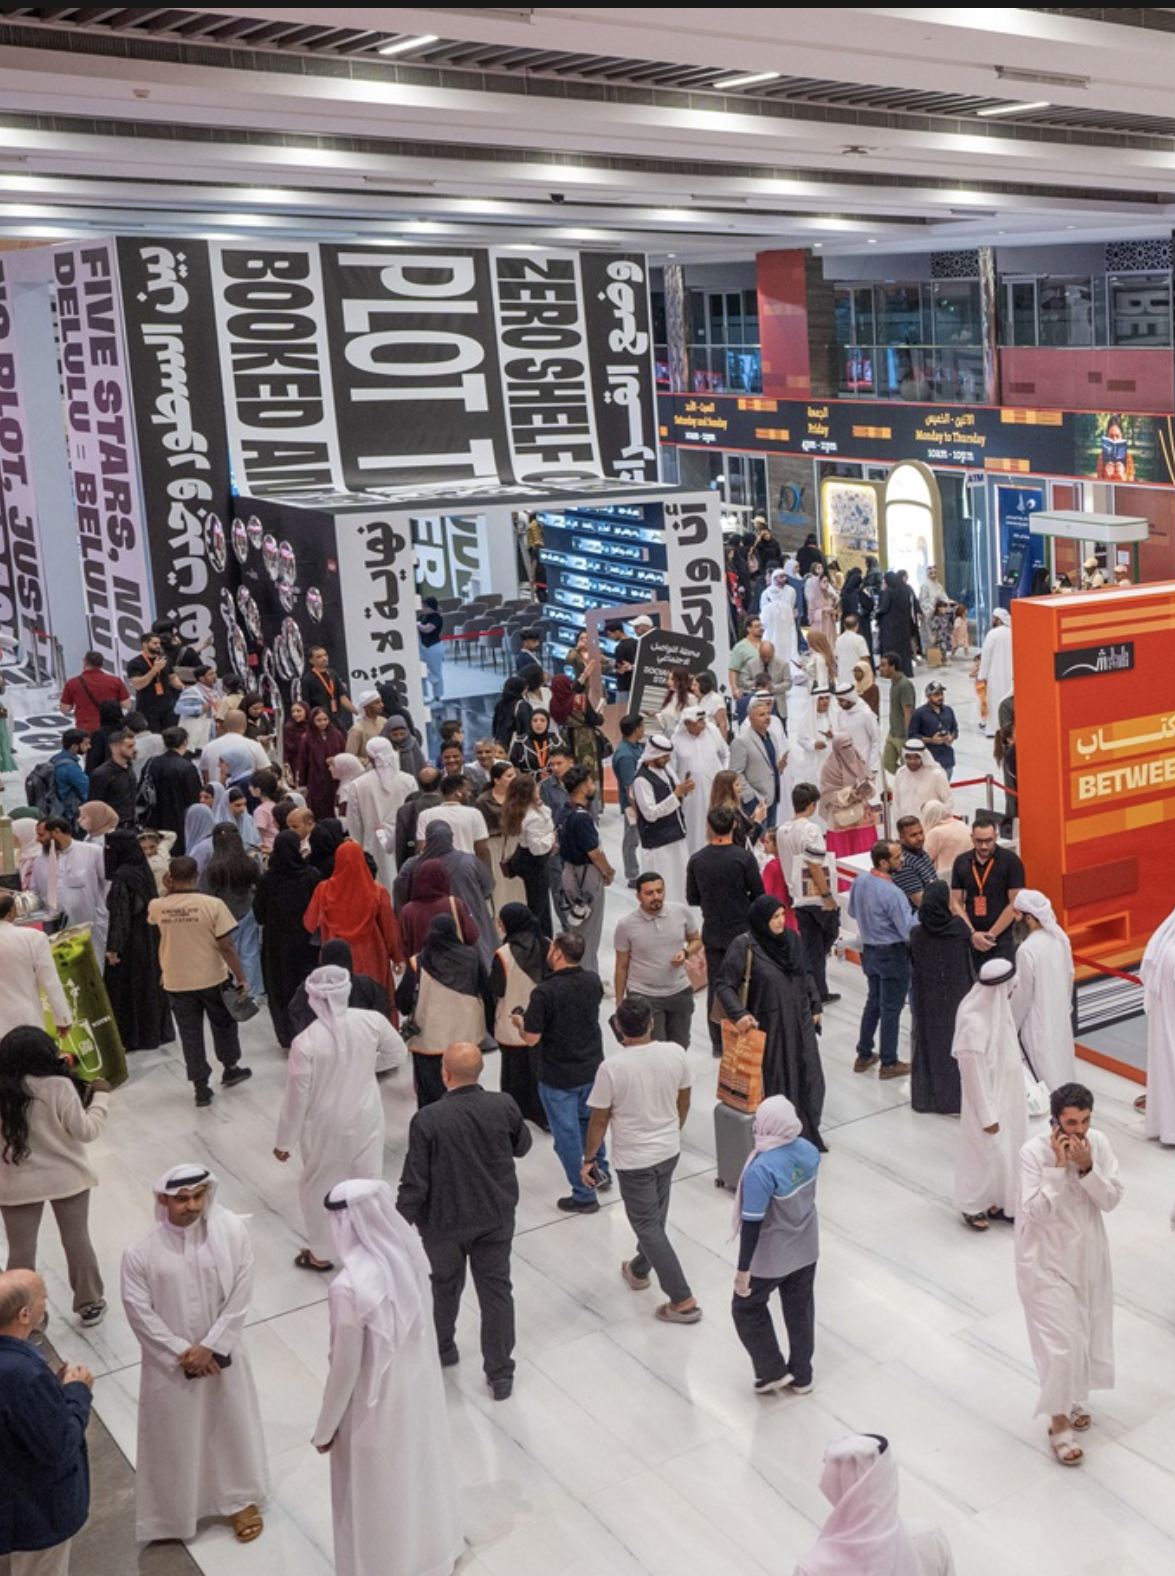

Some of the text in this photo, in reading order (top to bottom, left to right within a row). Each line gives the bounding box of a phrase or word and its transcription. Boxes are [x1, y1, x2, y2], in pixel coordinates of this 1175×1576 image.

[80, 246, 119, 366] FIVE
[136, 245, 189, 314] بين
[338, 252, 488, 412] PLOT
[495, 257, 582, 350] ZERO
[221, 248, 324, 428] BOOKED
[597, 260, 656, 483] وضع القرا
[54, 251, 91, 433] DELULU
[74, 470, 113, 650] BELULU
[140, 322, 211, 470] السطور
[504, 357, 594, 462] SHELF
[915, 430, 986, 447] Monday to Thursday
[93, 379, 136, 562] STARS,
[665, 502, 708, 546] أنا
[967, 473, 984, 483] ATM
[166, 478, 213, 595] وجدت
[357, 521, 407, 620] نهاية
[370, 629, 404, 653] لا
